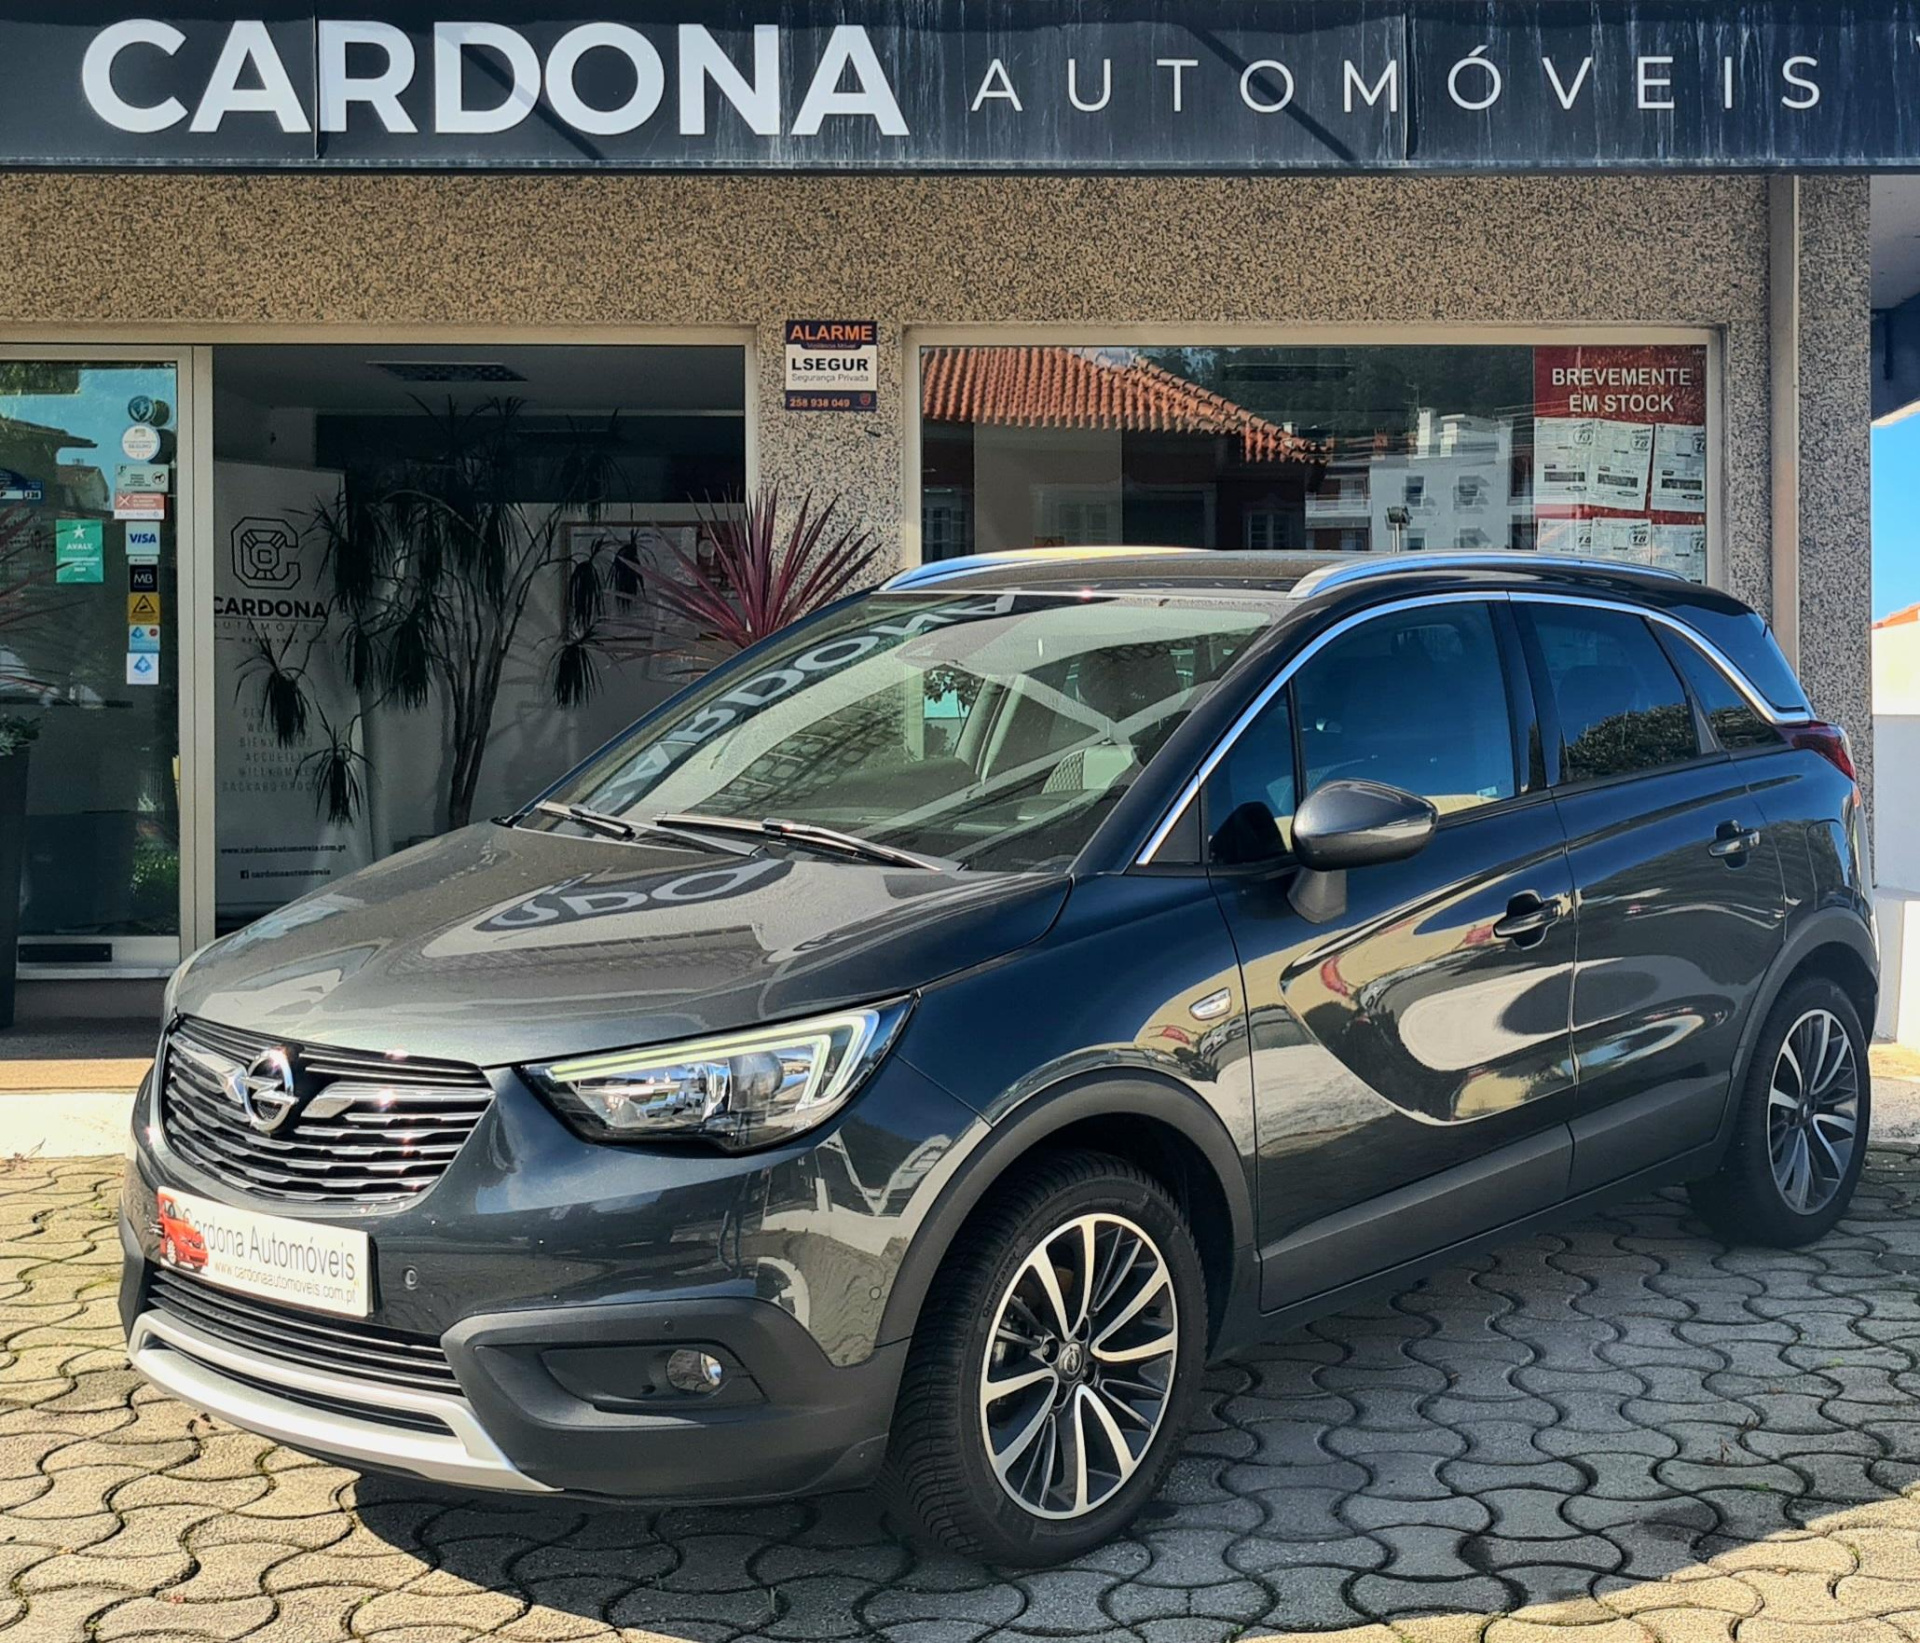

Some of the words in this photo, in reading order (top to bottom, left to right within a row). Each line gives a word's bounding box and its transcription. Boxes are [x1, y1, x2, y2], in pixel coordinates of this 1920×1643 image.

[81, 18, 910, 137] CARDONA
[970, 45, 1821, 113] AUTOMÓVEIS
[790, 325, 873, 341] ALARME
[791, 358, 868, 371] LSEGUR
[791, 374, 836, 383] Segurança
[838, 373, 869, 382] Privada
[1552, 367, 1692, 386] BREVEMENTE
[1569, 394, 1598, 413] EM
[1604, 394, 1675, 413] STOCK
[129, 533, 157, 544] VISA
[134, 573, 153, 584] MB
[214, 597, 328, 619] CARDONA
[250, 1225, 356, 1281] Automóveis
